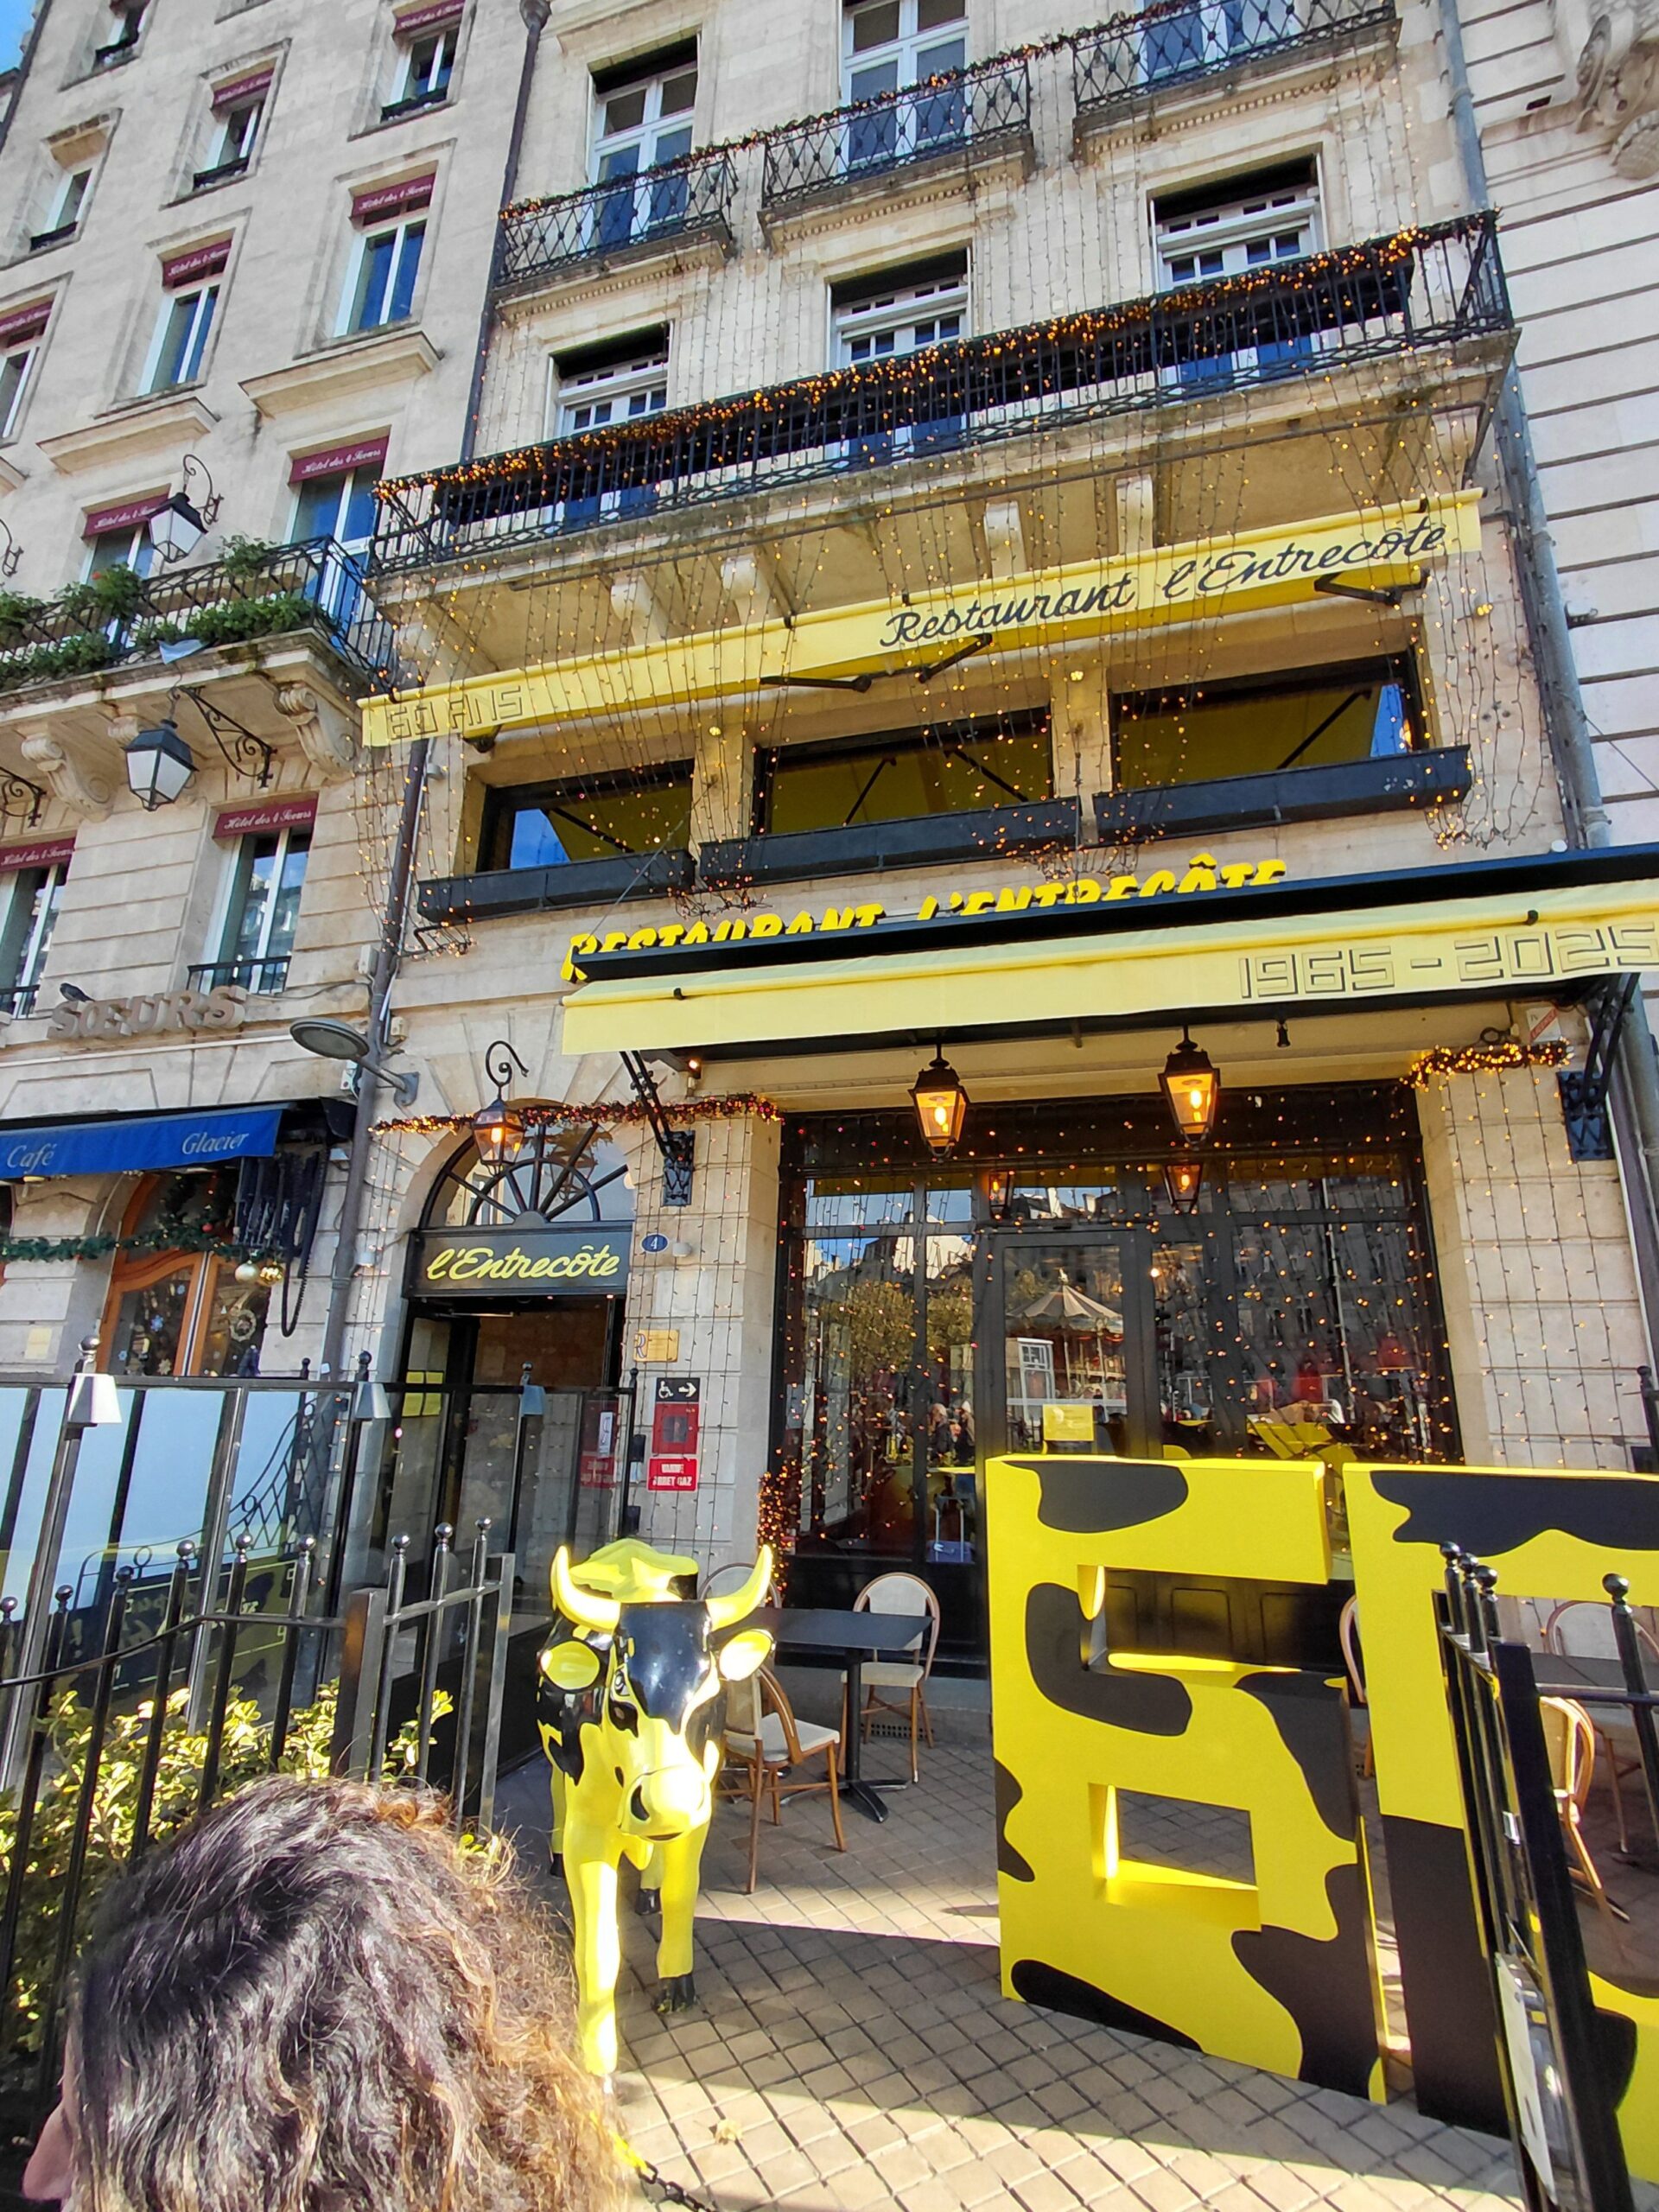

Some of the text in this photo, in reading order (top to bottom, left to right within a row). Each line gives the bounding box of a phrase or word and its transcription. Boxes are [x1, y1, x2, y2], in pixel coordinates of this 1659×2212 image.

[880, 516, 1446, 647] Restaurant l'Entrecôte
[387, 685, 523, 741] 60 ANS
[225, 815, 256, 830] Hôtel
[255, 813, 270, 825] des
[273, 812, 279, 823] 4
[7, 1130, 249, 1174] Café Glacier
[650, 1236, 658, 1249] 4
[427, 1244, 620, 1281] l'Entrecôte
[677, 1476, 692, 1486] GAZ
